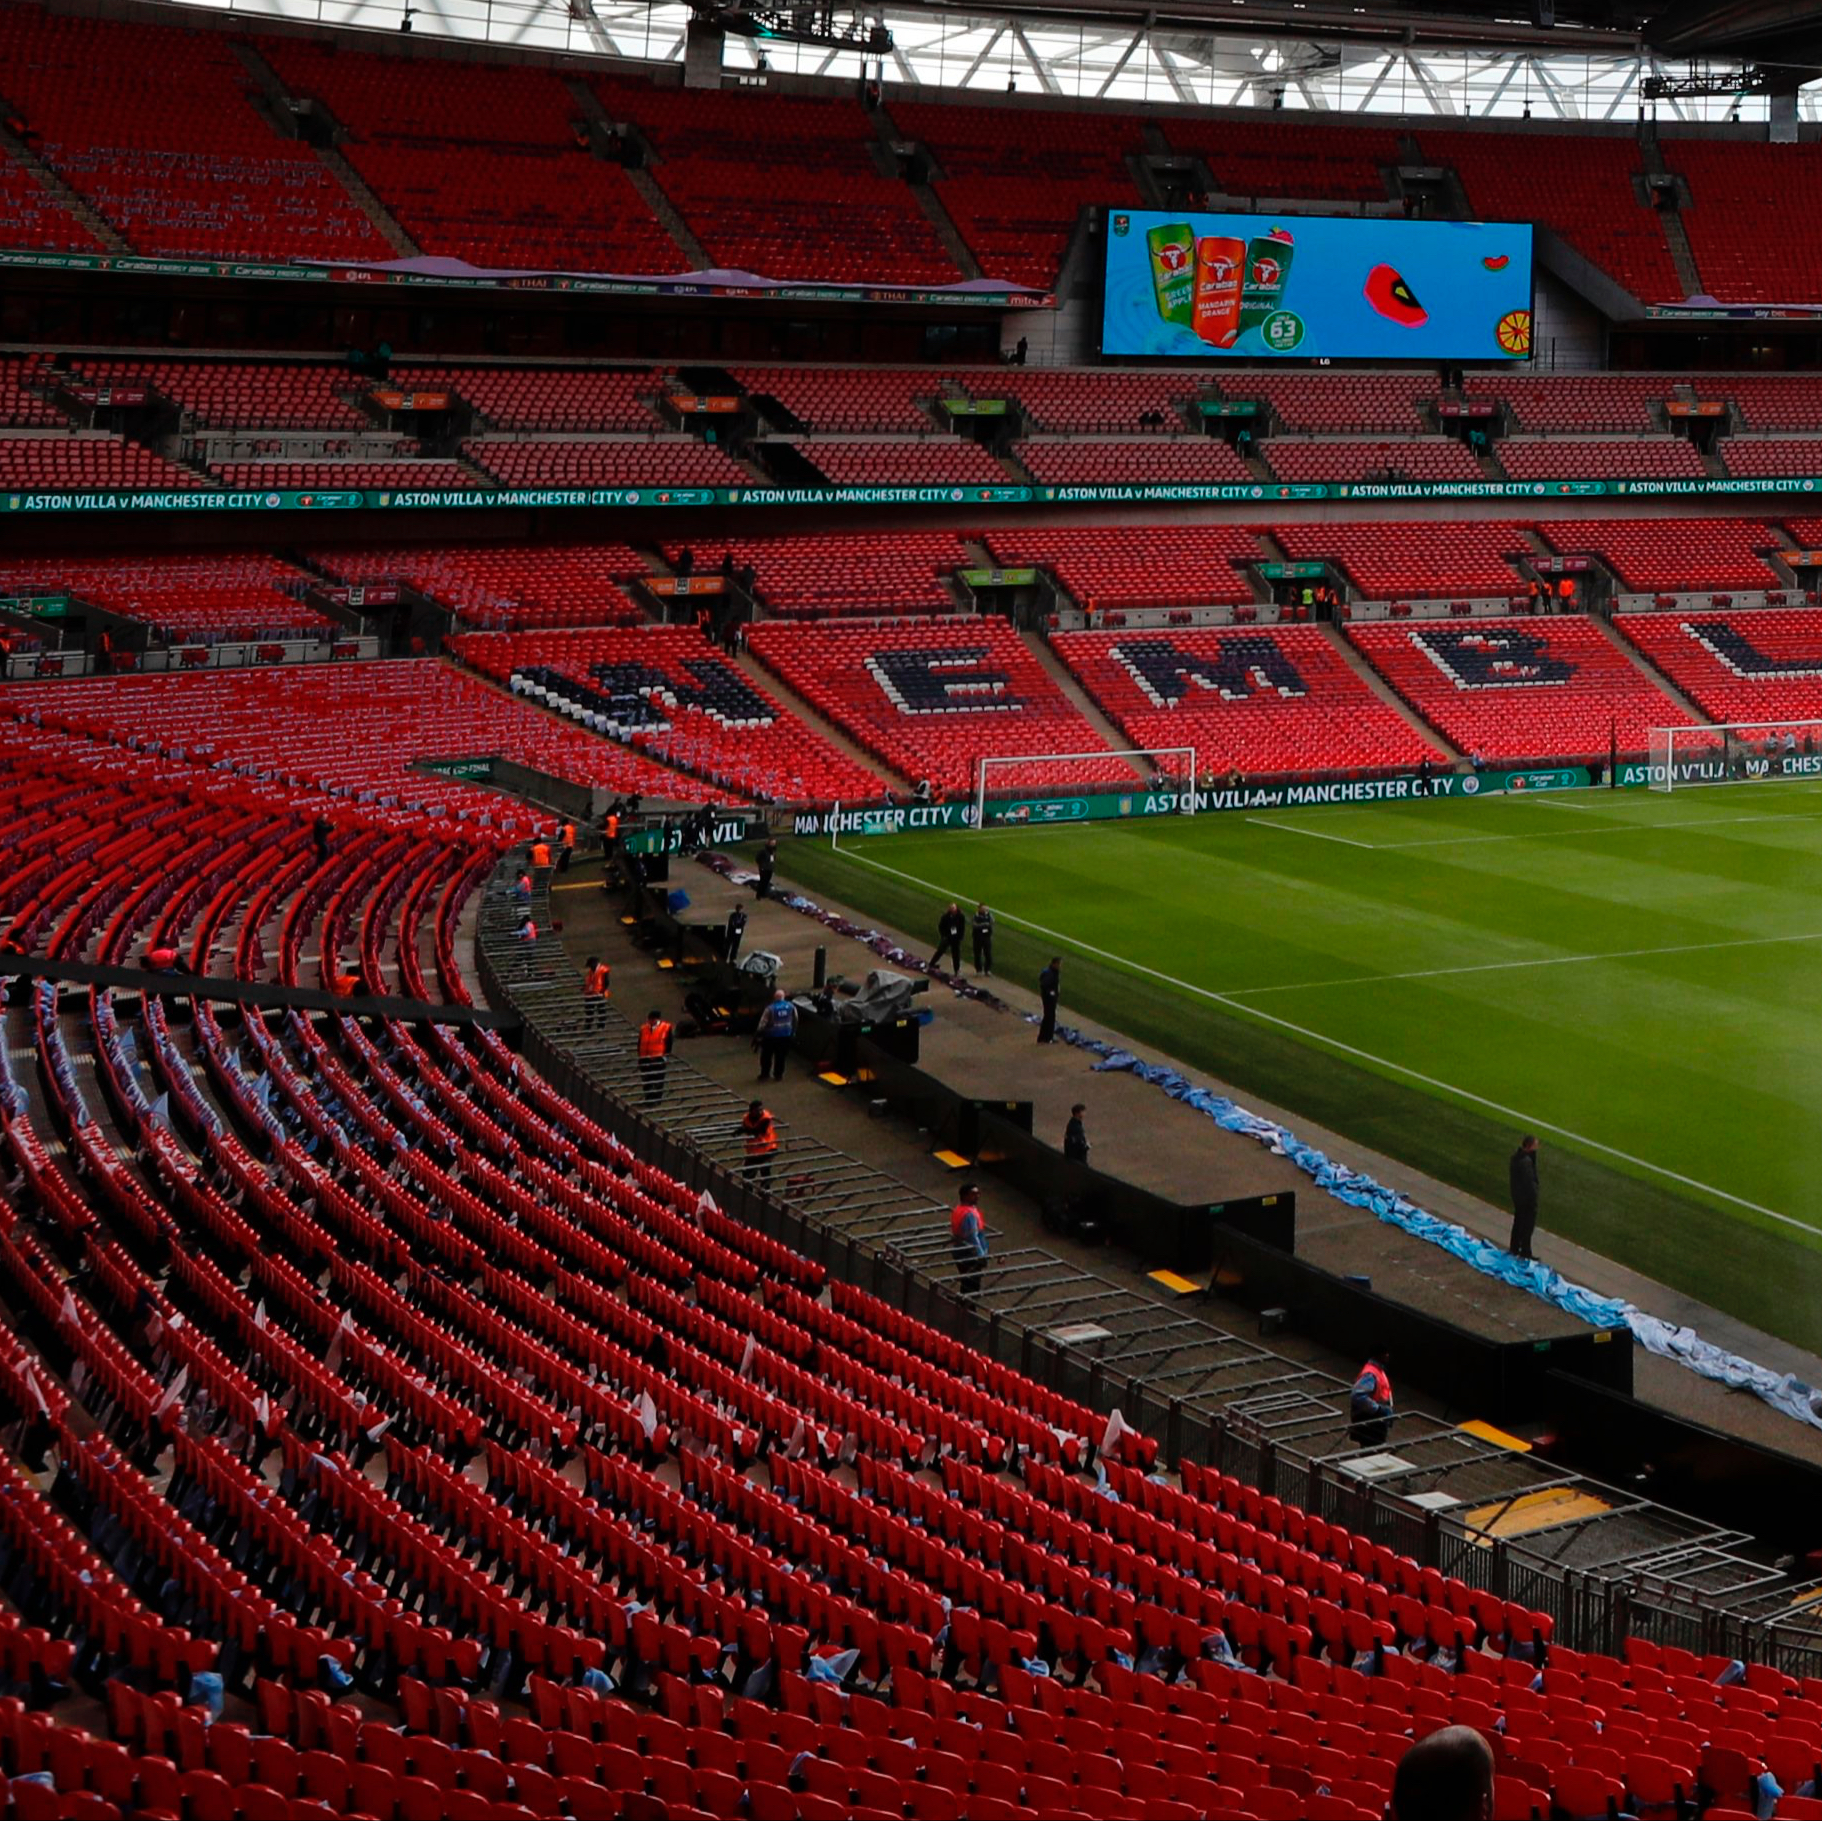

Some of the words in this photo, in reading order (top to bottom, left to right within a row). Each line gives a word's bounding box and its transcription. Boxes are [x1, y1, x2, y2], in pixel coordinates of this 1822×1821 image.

[1270, 320, 1296, 339] 63
[1319, 357, 1330, 365] LG
[395, 493, 440, 505] ASTON
[444, 493, 482, 504] VILLA
[487, 496, 494, 504] v
[498, 493, 585, 503] MANCHESTER
[589, 492, 621, 503] CITY
[1059, 488, 1096, 498] ASTON
[1099, 488, 1132, 498] VILLA
[1145, 488, 1219, 497] MANCHESTER
[1222, 488, 1247, 496] CITY
[26, 496, 71, 508] ASTON
[76, 496, 115, 508] VILLA
[121, 499, 128, 507] v
[132, 495, 225, 507] MANCHESTER
[229, 495, 261, 506] CITY
[1624, 764, 1678, 784] ASTON
[1144, 792, 1207, 814] ASTON
[1212, 789, 1268, 810] VILLA
[1287, 780, 1407, 805] MANCHESTER
[1411, 778, 1453, 797] CTY
[910, 805, 953, 826] CITY
